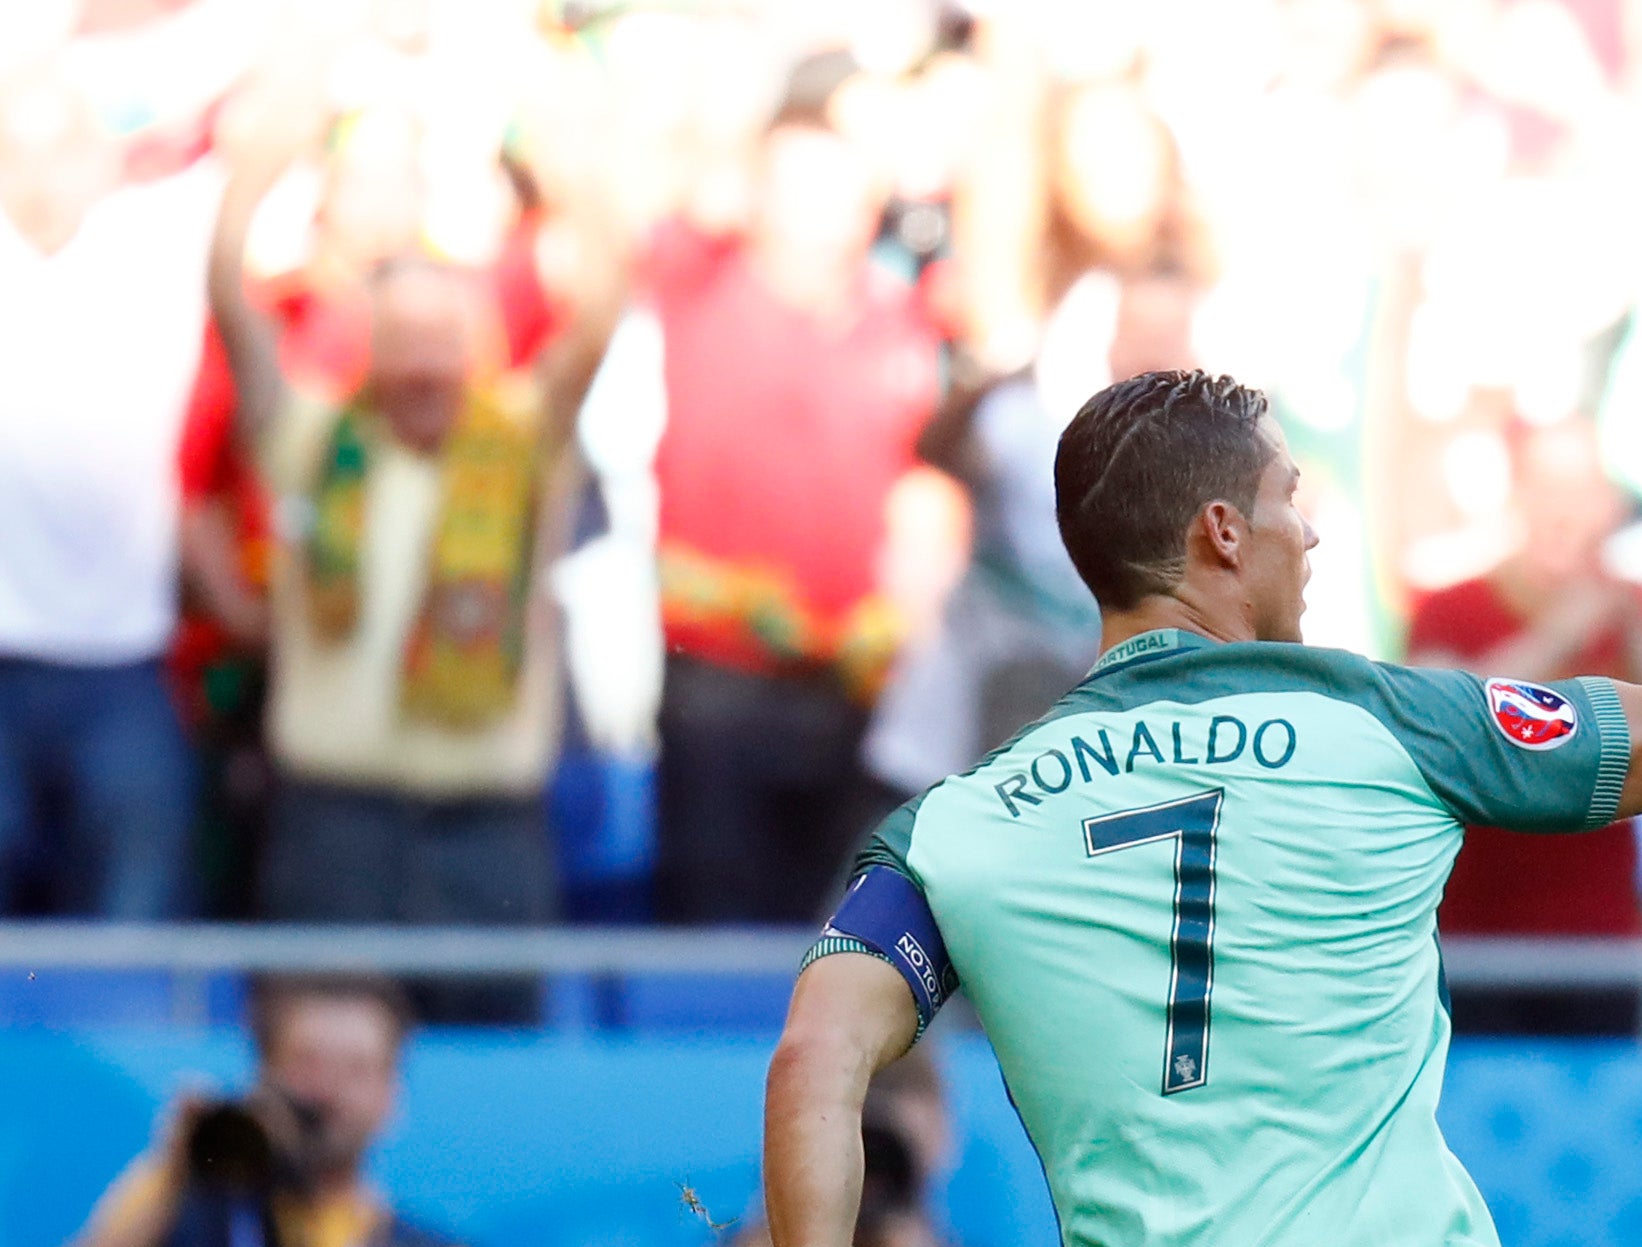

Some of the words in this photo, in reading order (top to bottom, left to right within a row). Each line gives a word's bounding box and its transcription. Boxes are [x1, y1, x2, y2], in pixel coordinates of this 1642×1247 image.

[1096, 634, 1168, 667] ORTUGAL
[994, 715, 1296, 818] RONALDO
[898, 936, 924, 967] NO
[921, 965, 937, 993] TO
[1082, 787, 1226, 1096] 7
